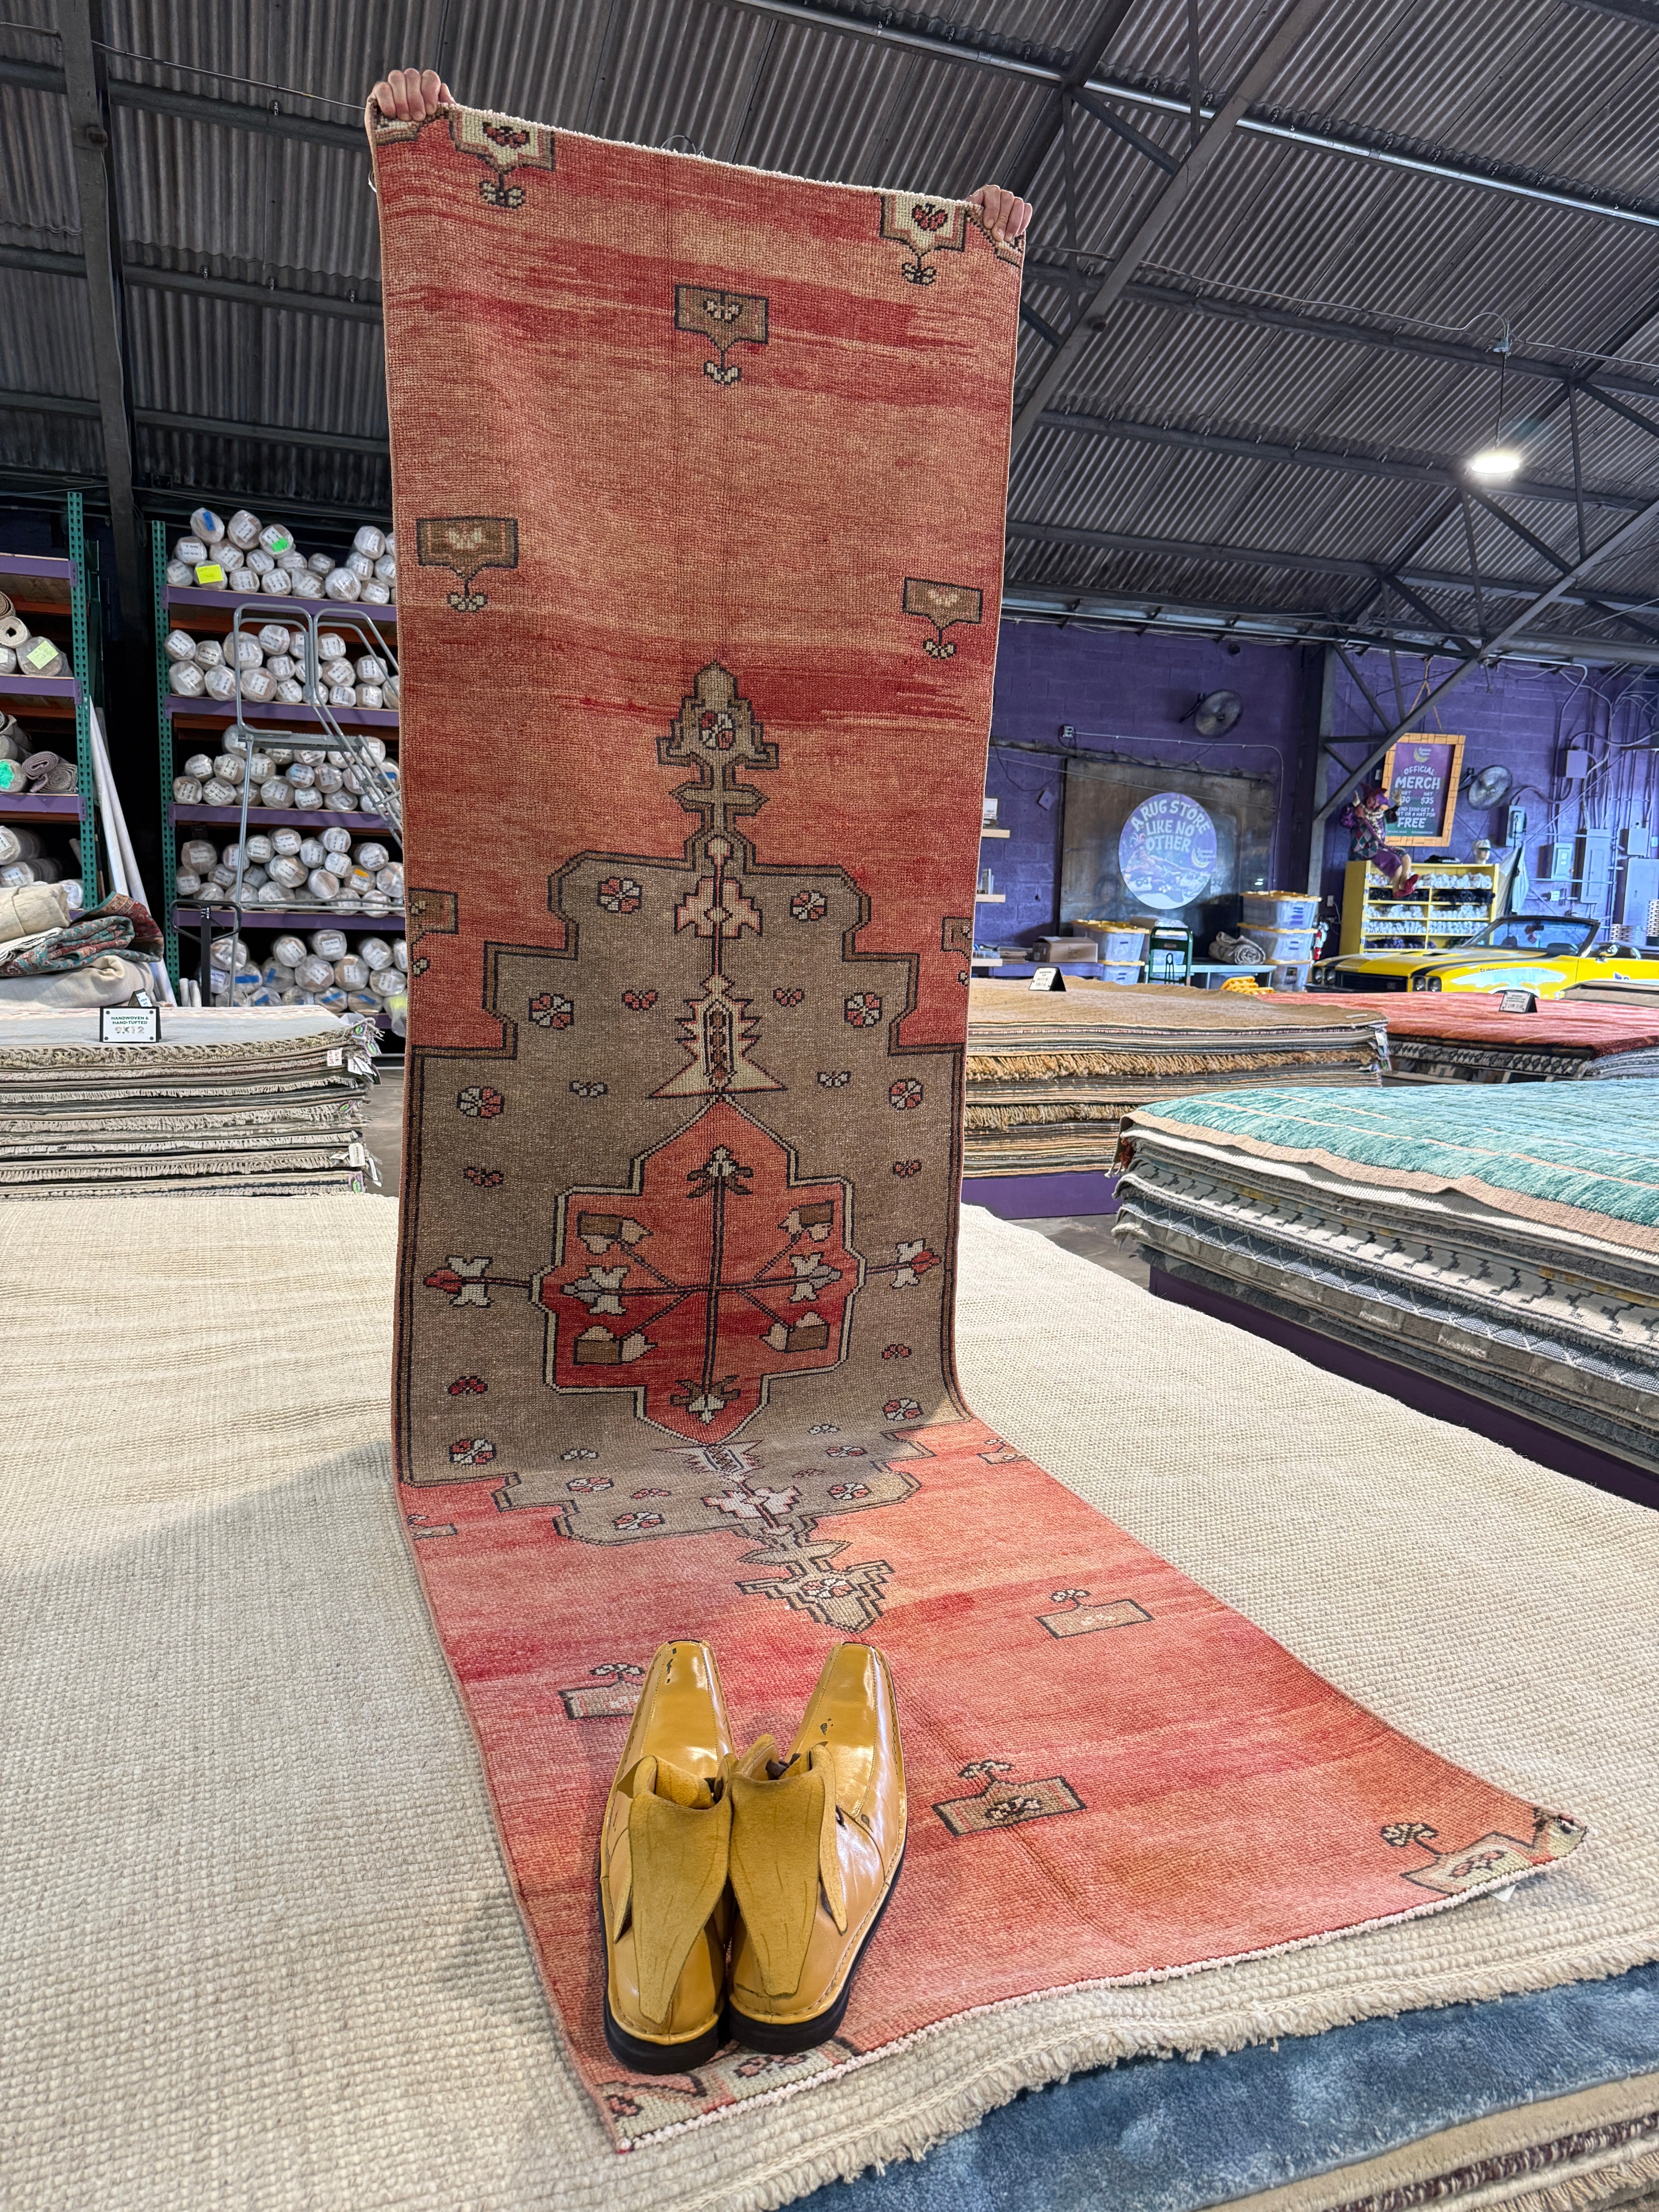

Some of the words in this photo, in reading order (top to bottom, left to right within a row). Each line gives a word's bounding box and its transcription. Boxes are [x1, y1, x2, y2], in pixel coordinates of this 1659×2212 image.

[1404, 766, 1434, 776] OFFICIAL
[1395, 776, 1440, 790] MERCH
[1131, 816, 1144, 831] A
[1140, 799, 1167, 821] RUG
[1170, 800, 1211, 834] STORE
[1397, 817, 1426, 828] FREE
[1146, 819, 1173, 835] LIKE
[1175, 820, 1195, 837] NO
[1146, 835, 1192, 852] OTHER
